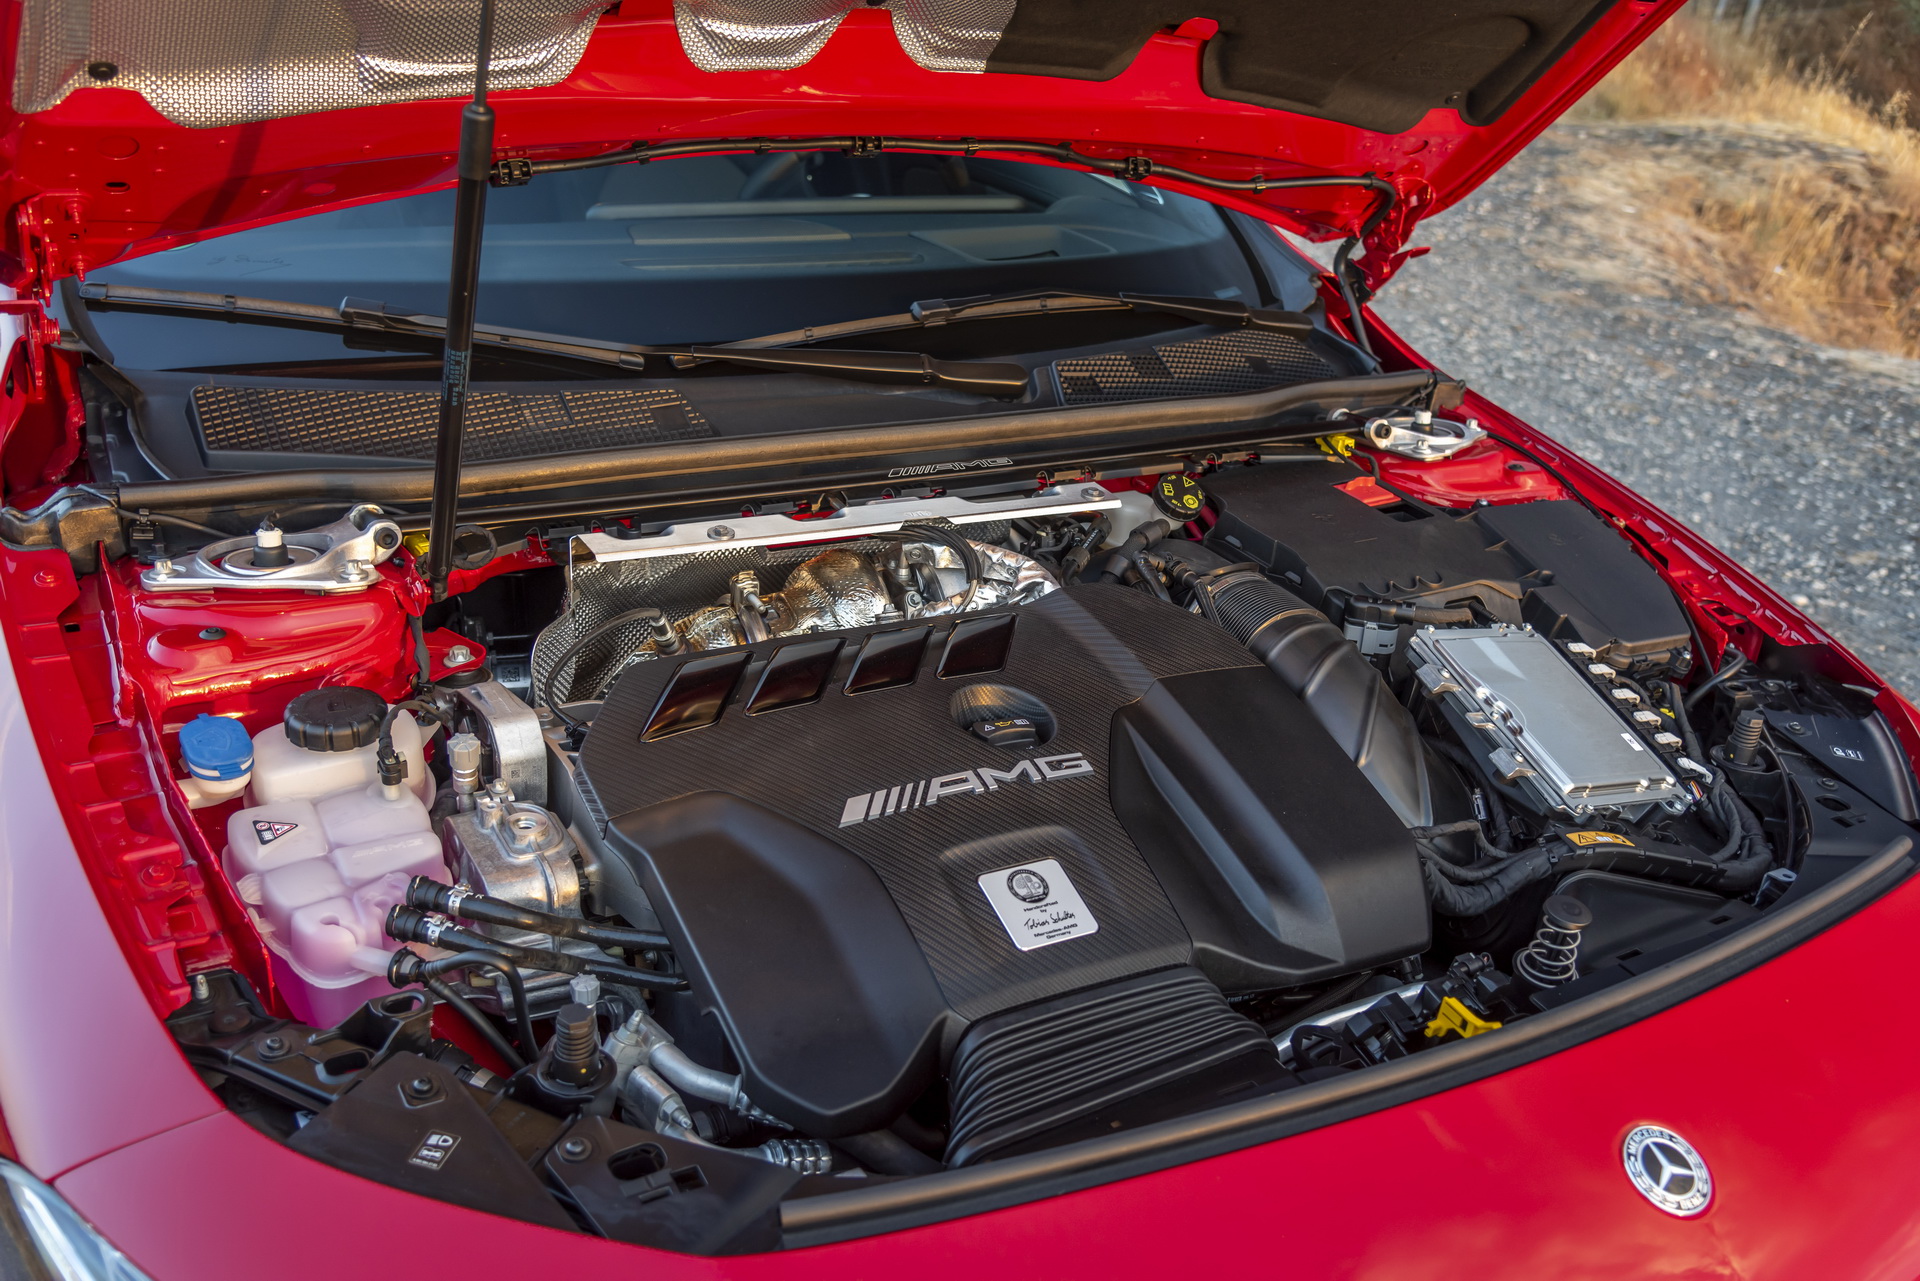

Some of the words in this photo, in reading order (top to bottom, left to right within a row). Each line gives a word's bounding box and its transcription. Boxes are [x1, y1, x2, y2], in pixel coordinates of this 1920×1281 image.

[925, 752, 1095, 806] AMG
[1023, 901, 1058, 912] Handcrafted
[1024, 918, 1050, 930] Tobias
[1034, 923, 1078, 938] Mercedes-AMG
[1046, 931, 1071, 940] Germany
[1627, 1128, 1670, 1155] MERCEDES
